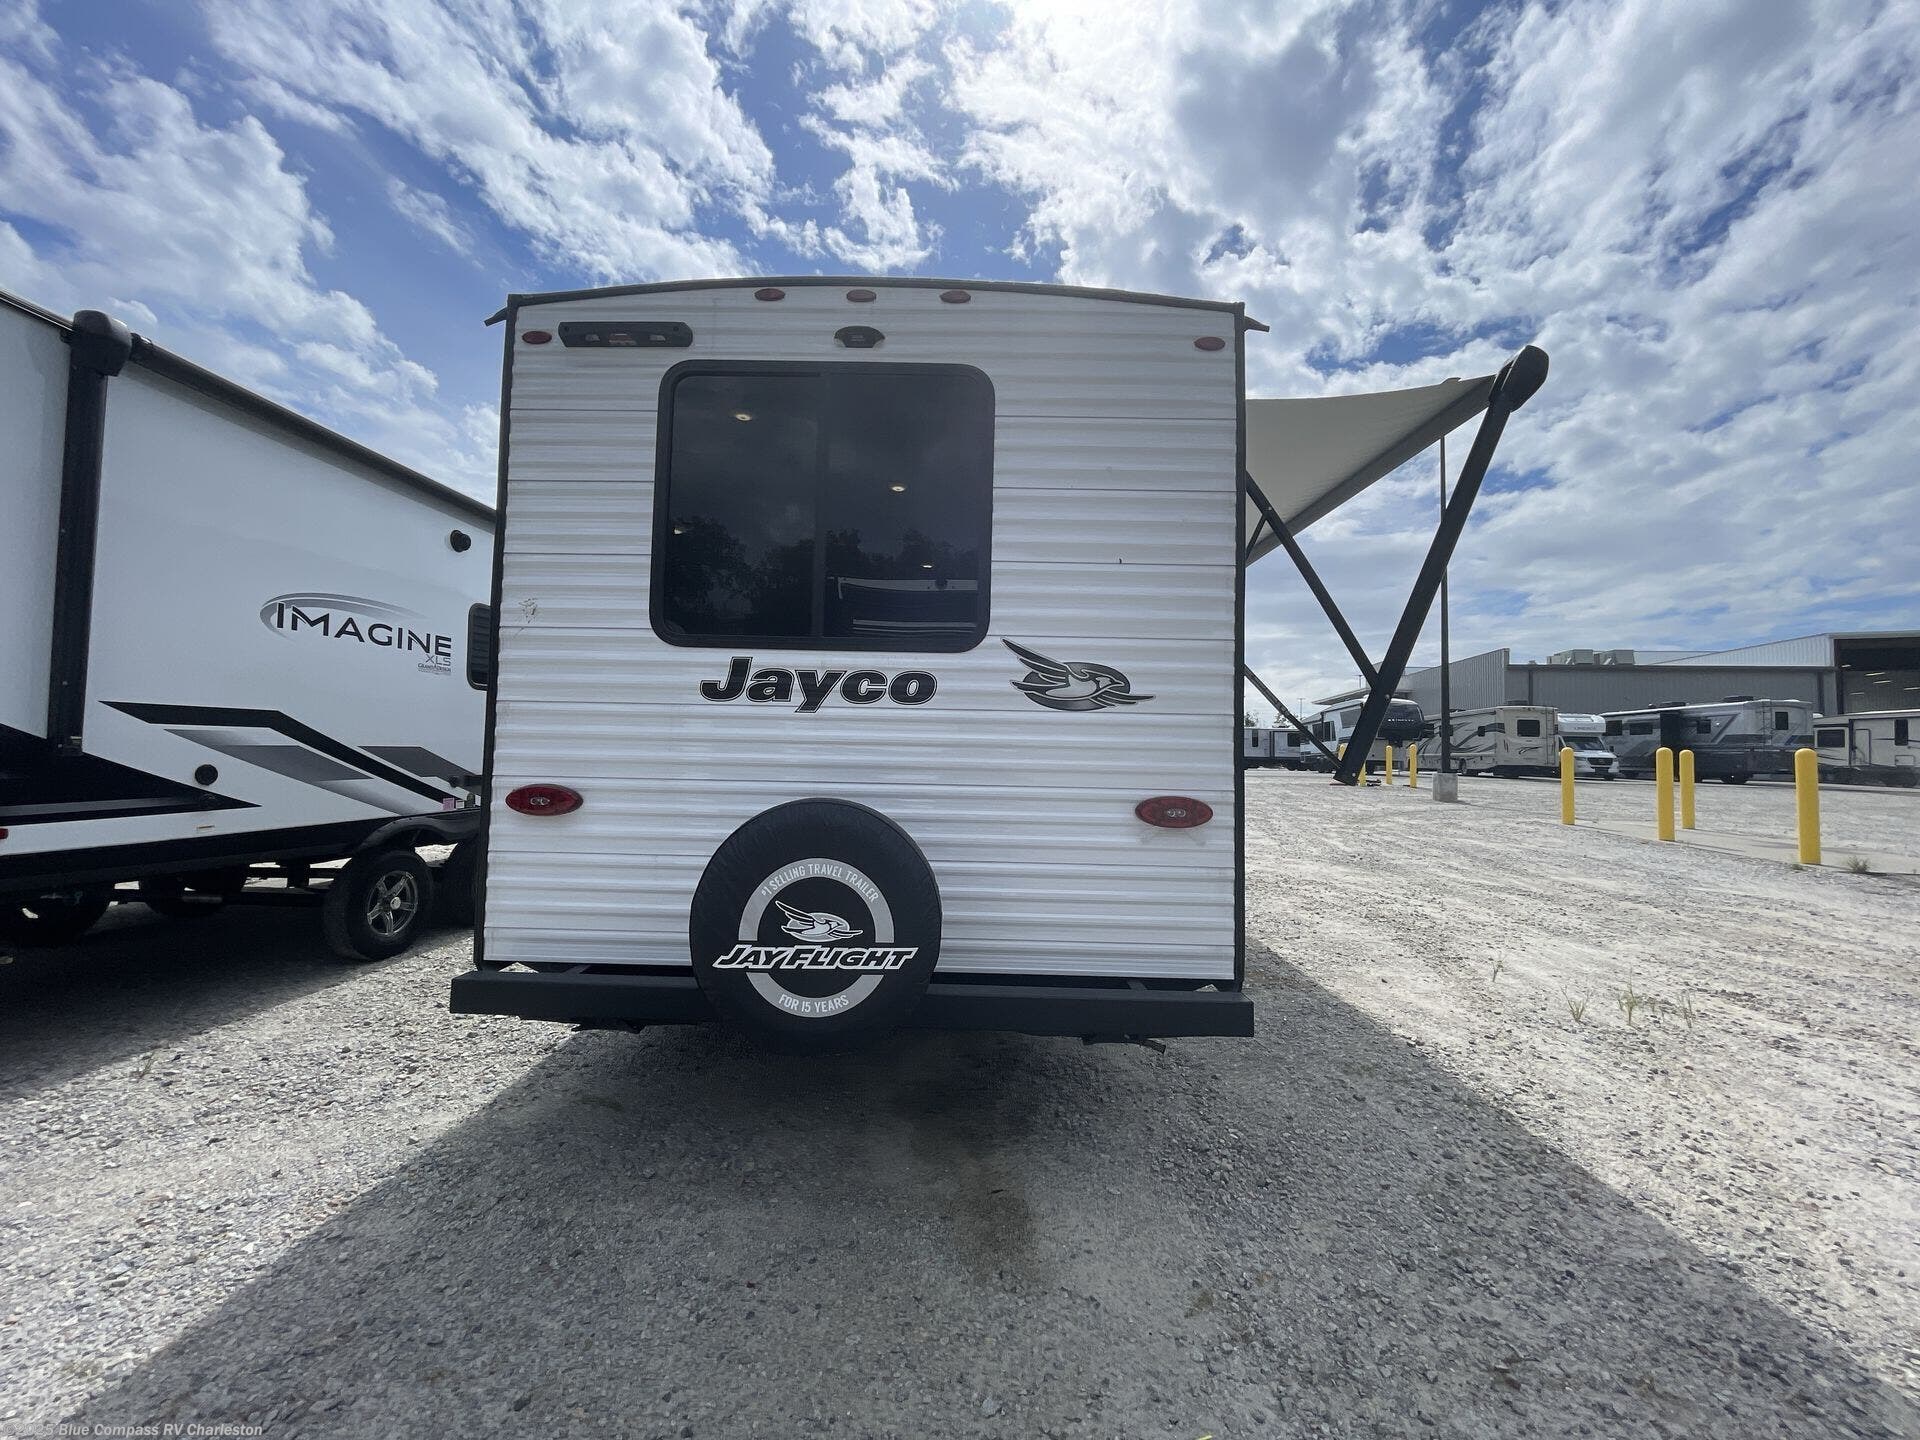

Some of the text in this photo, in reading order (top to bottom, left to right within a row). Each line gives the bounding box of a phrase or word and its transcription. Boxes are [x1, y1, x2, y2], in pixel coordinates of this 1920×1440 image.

[277, 602, 451, 657] IMAGINE
[425, 653, 451, 667] XLS
[700, 656, 937, 713] Jayco
[769, 865, 806, 891] SELLING
[807, 863, 842, 878] TRAVEL
[845, 871, 879, 903] TRAILER
[778, 994, 849, 1013] FOR 15 YEARS
